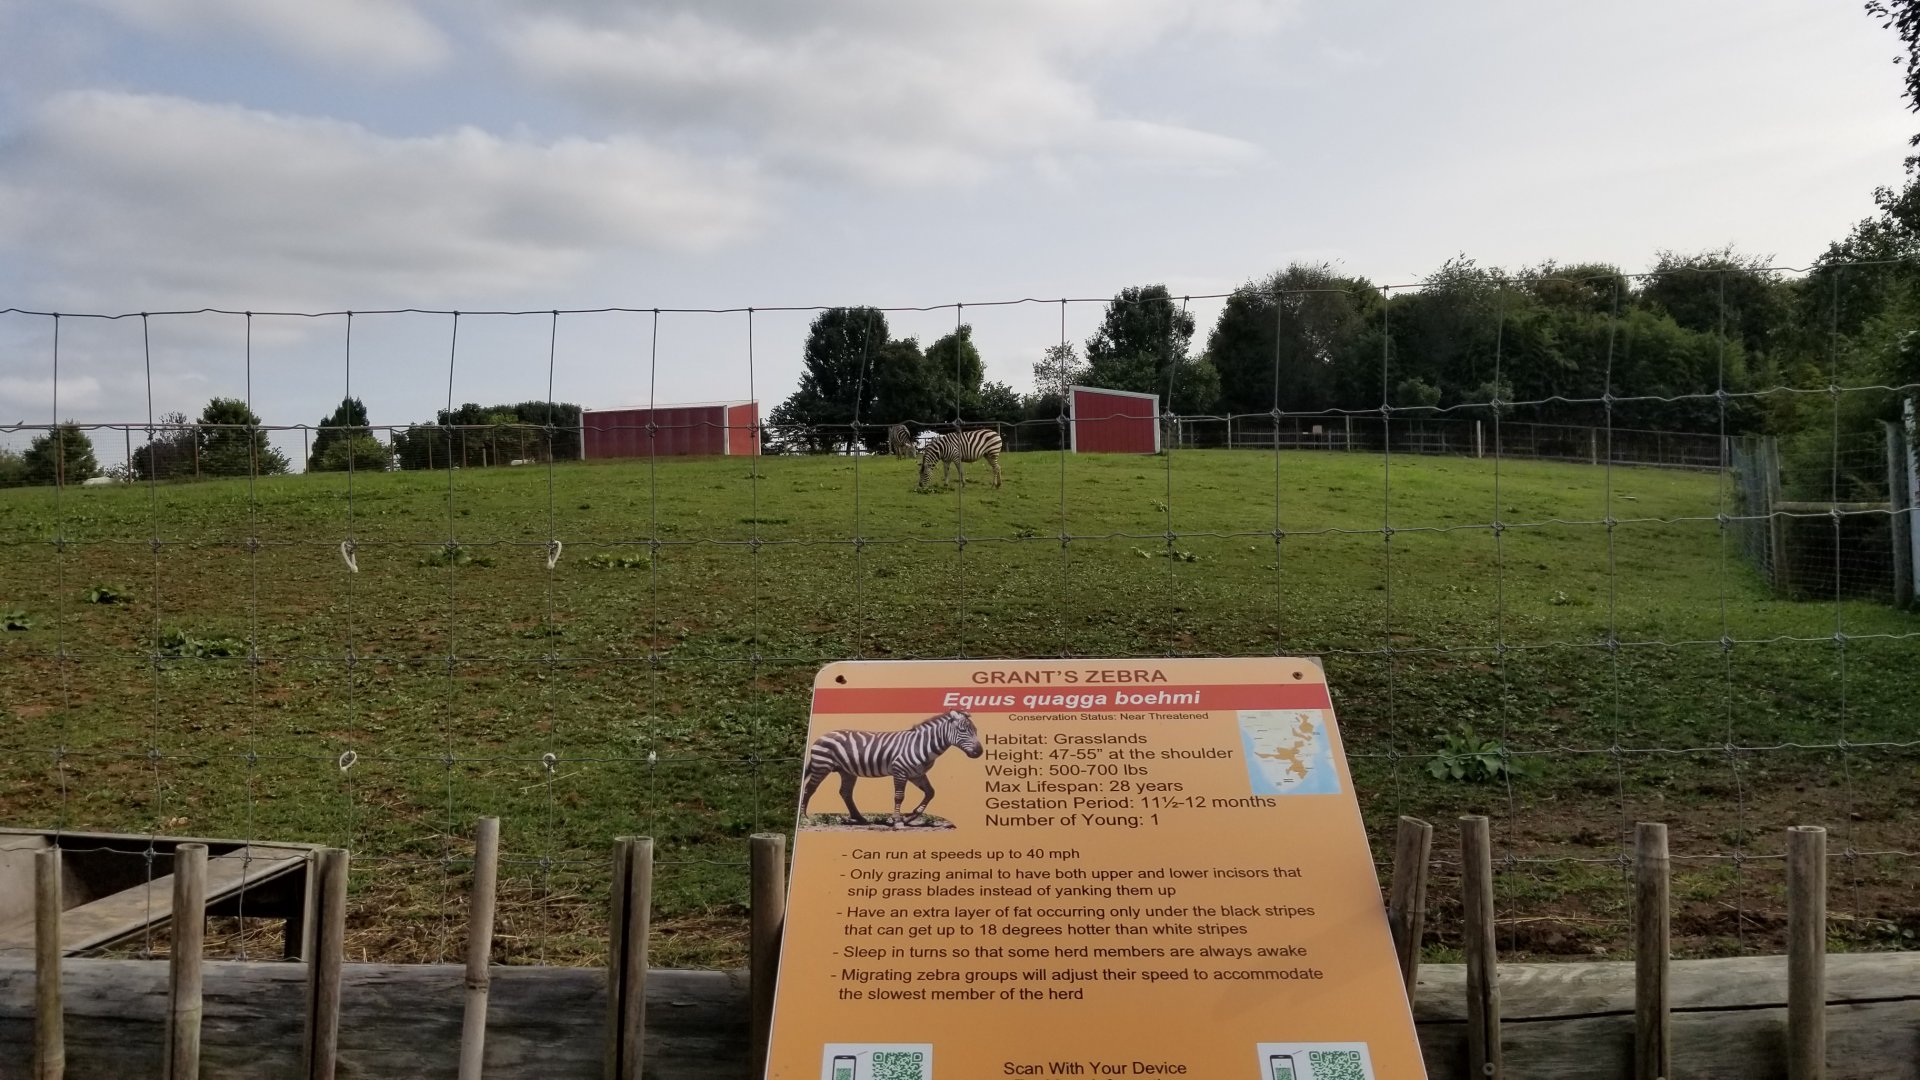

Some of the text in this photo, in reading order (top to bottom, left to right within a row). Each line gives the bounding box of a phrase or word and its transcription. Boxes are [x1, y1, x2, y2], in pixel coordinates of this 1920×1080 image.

[1085, 669, 1168, 683] ZEBRA
[943, 690, 1201, 710] Equus quagga boehmi
[1008, 712, 1209, 722] Conservation Status: Near Threatened
[985, 733, 1148, 745] Habitat: Grasslands
[985, 749, 1043, 763] Height:
[1108, 748, 1125, 760] at
[1129, 748, 1155, 760] the
[1161, 747, 1233, 760] shoulder
[984, 764, 1148, 779] Weigh: 500-700 lbs
[985, 780, 1184, 795] Max Lifespan: 28 years
[985, 797, 1067, 810] Gestation
[1073, 796, 1134, 809] Period:
[1212, 795, 1277, 808] months
[986, 813, 1158, 829] Number of Young: 1
[852, 848, 881, 860] Can
[885, 851, 908, 860] run
[913, 849, 926, 860] at
[930, 848, 982, 862] speeds
[987, 851, 1004, 862] up
[1008, 849, 1022, 859] to
[1026, 848, 1044, 859] 40
[1049, 848, 1080, 862] mph
[850, 868, 884, 882] Only
[887, 868, 941, 882] grazing
[945, 868, 993, 880] animal
[997, 869, 1011, 879] to
[1015, 868, 1051, 879] have
[1055, 868, 1087, 879] both
[1091, 870, 1134, 882] upper
[1138, 867, 1165, 879] and
[1169, 867, 1209, 879] lower
[1213, 867, 1270, 878] incisors
[1273, 867, 1302, 878] that
[847, 884, 1176, 899] snip grass blades instead of yanking them up
[847, 906, 885, 918] Have
[890, 909, 908, 918] an
[913, 907, 950, 918] extra
[954, 906, 991, 921] layer
[995, 906, 1010, 918] of
[1013, 906, 1033, 918] fat
[1036, 906, 1105, 920] occurring
[1110, 906, 1141, 920] only
[1145, 905, 1189, 917] under
[1192, 905, 1216, 917] the
[1220, 905, 1261, 917] black
[1265, 905, 1315, 919] stripes
[844, 923, 1248, 939] that can get up to 18 degrees hotter than white stripes
[843, 945, 887, 961] Sleep
[892, 946, 904, 958] in
[909, 946, 948, 958] turns
[952, 948, 970, 958] so
[974, 946, 1004, 958] that
[1008, 948, 1050, 958] some
[1054, 945, 1088, 958] herd
[1093, 945, 1165, 958] members
[1170, 948, 1195, 957] are
[1199, 945, 1253, 960] always
[1257, 944, 1307, 957] awake
[841, 968, 912, 984] Migrating
[916, 968, 960, 981] zebra
[965, 971, 1018, 984] groups
[1022, 968, 1047, 981] will
[1051, 968, 1099, 984] adjust
[1102, 968, 1137, 981] their
[1141, 968, 1189, 983] speed
[1193, 968, 1208, 980] to
[1213, 967, 1323, 980] accommodate
[839, 987, 1084, 1000] the slowest member of the herd
[1004, 1061, 1187, 1075] Scan With Your Device
